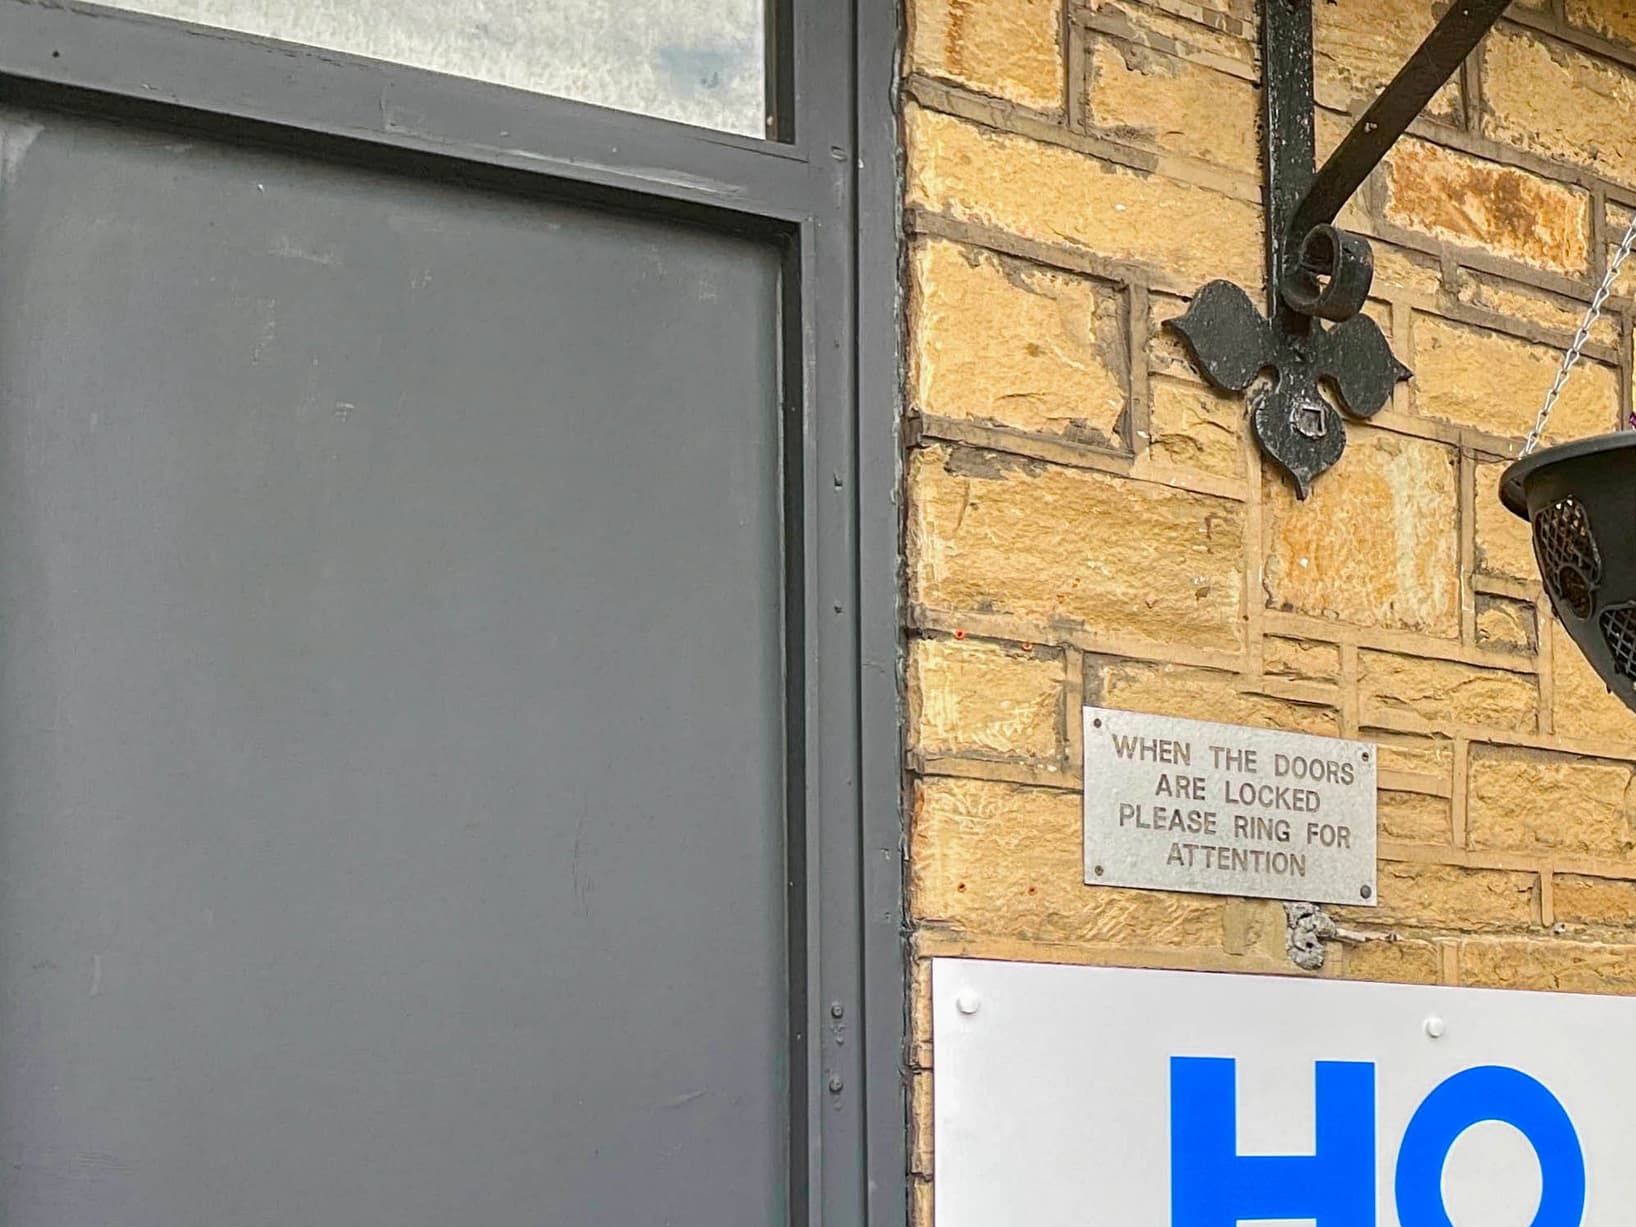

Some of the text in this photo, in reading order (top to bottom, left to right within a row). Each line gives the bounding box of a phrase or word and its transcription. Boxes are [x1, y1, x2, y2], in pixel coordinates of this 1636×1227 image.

[1112, 733, 1355, 786] WHEN THE DOORS
[1155, 773, 1321, 813] ARE LOCKED
[1118, 803, 1351, 849] PLEASE RING FOR
[1166, 842, 1307, 877] ATTENTION
